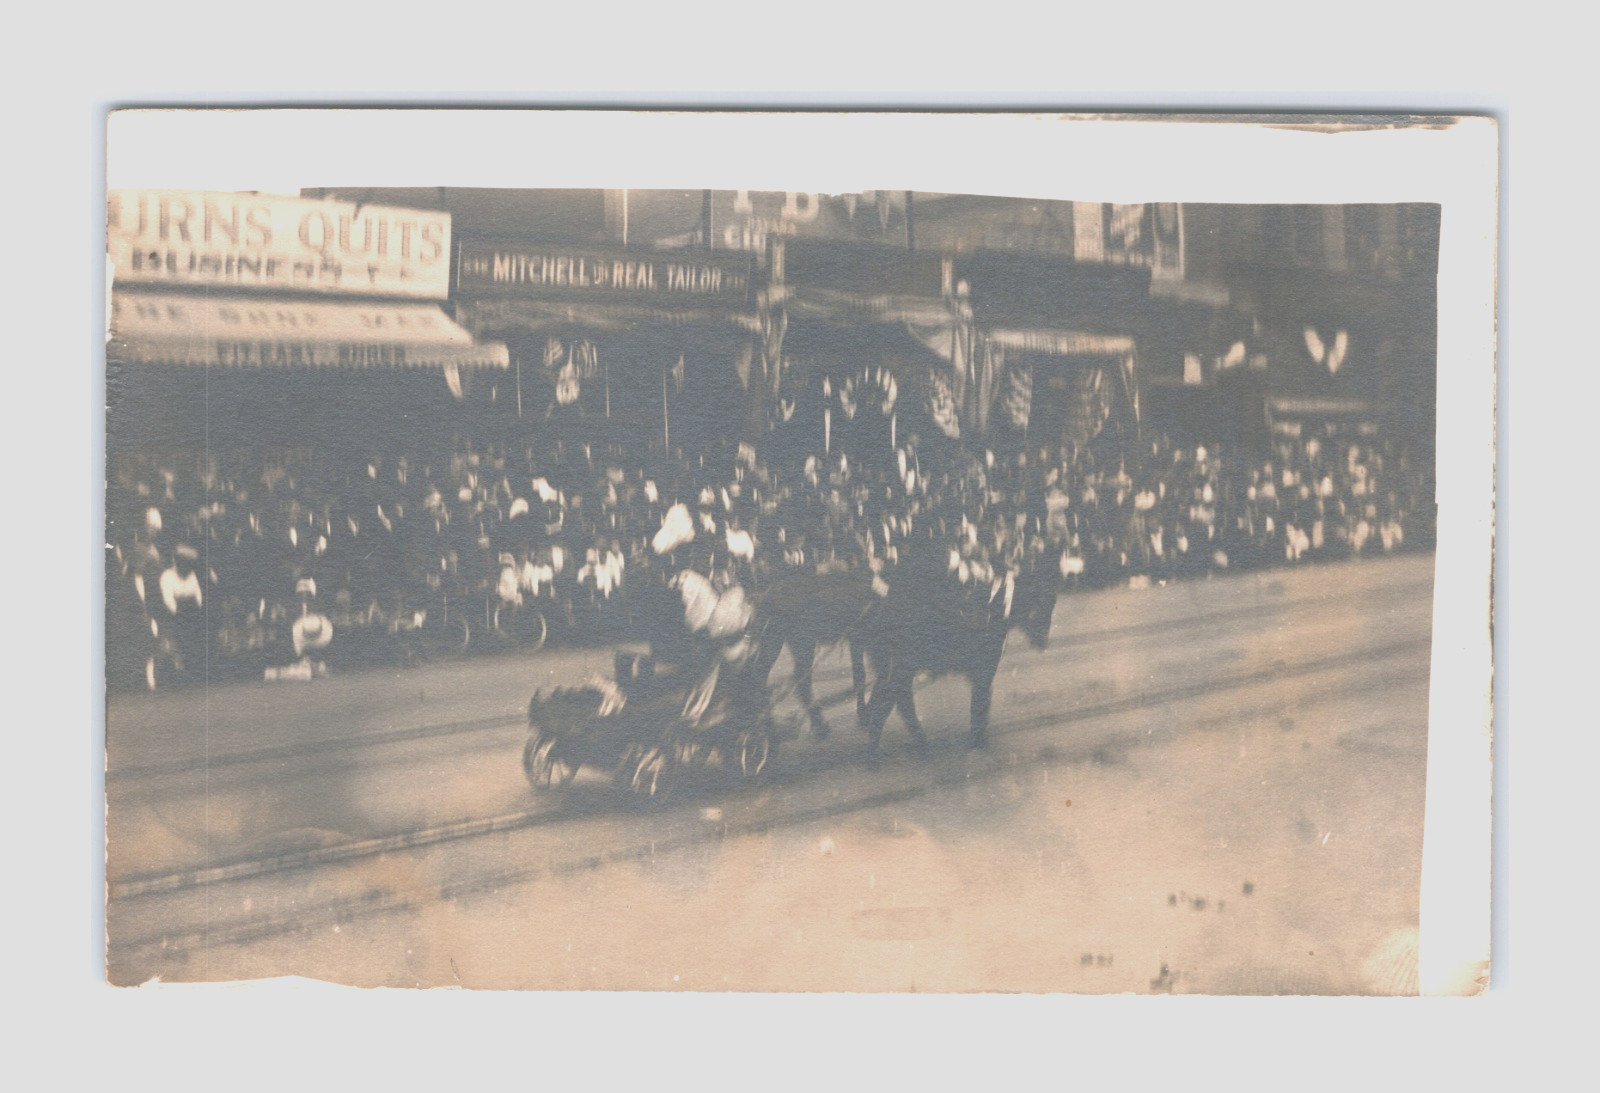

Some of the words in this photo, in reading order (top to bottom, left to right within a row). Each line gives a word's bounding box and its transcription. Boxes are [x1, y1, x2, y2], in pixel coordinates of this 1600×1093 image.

[297, 208, 443, 261] QUITS
[492, 251, 590, 288] MITCHELL
[611, 260, 658, 290] REAL
[666, 263, 722, 293] TAILOR
